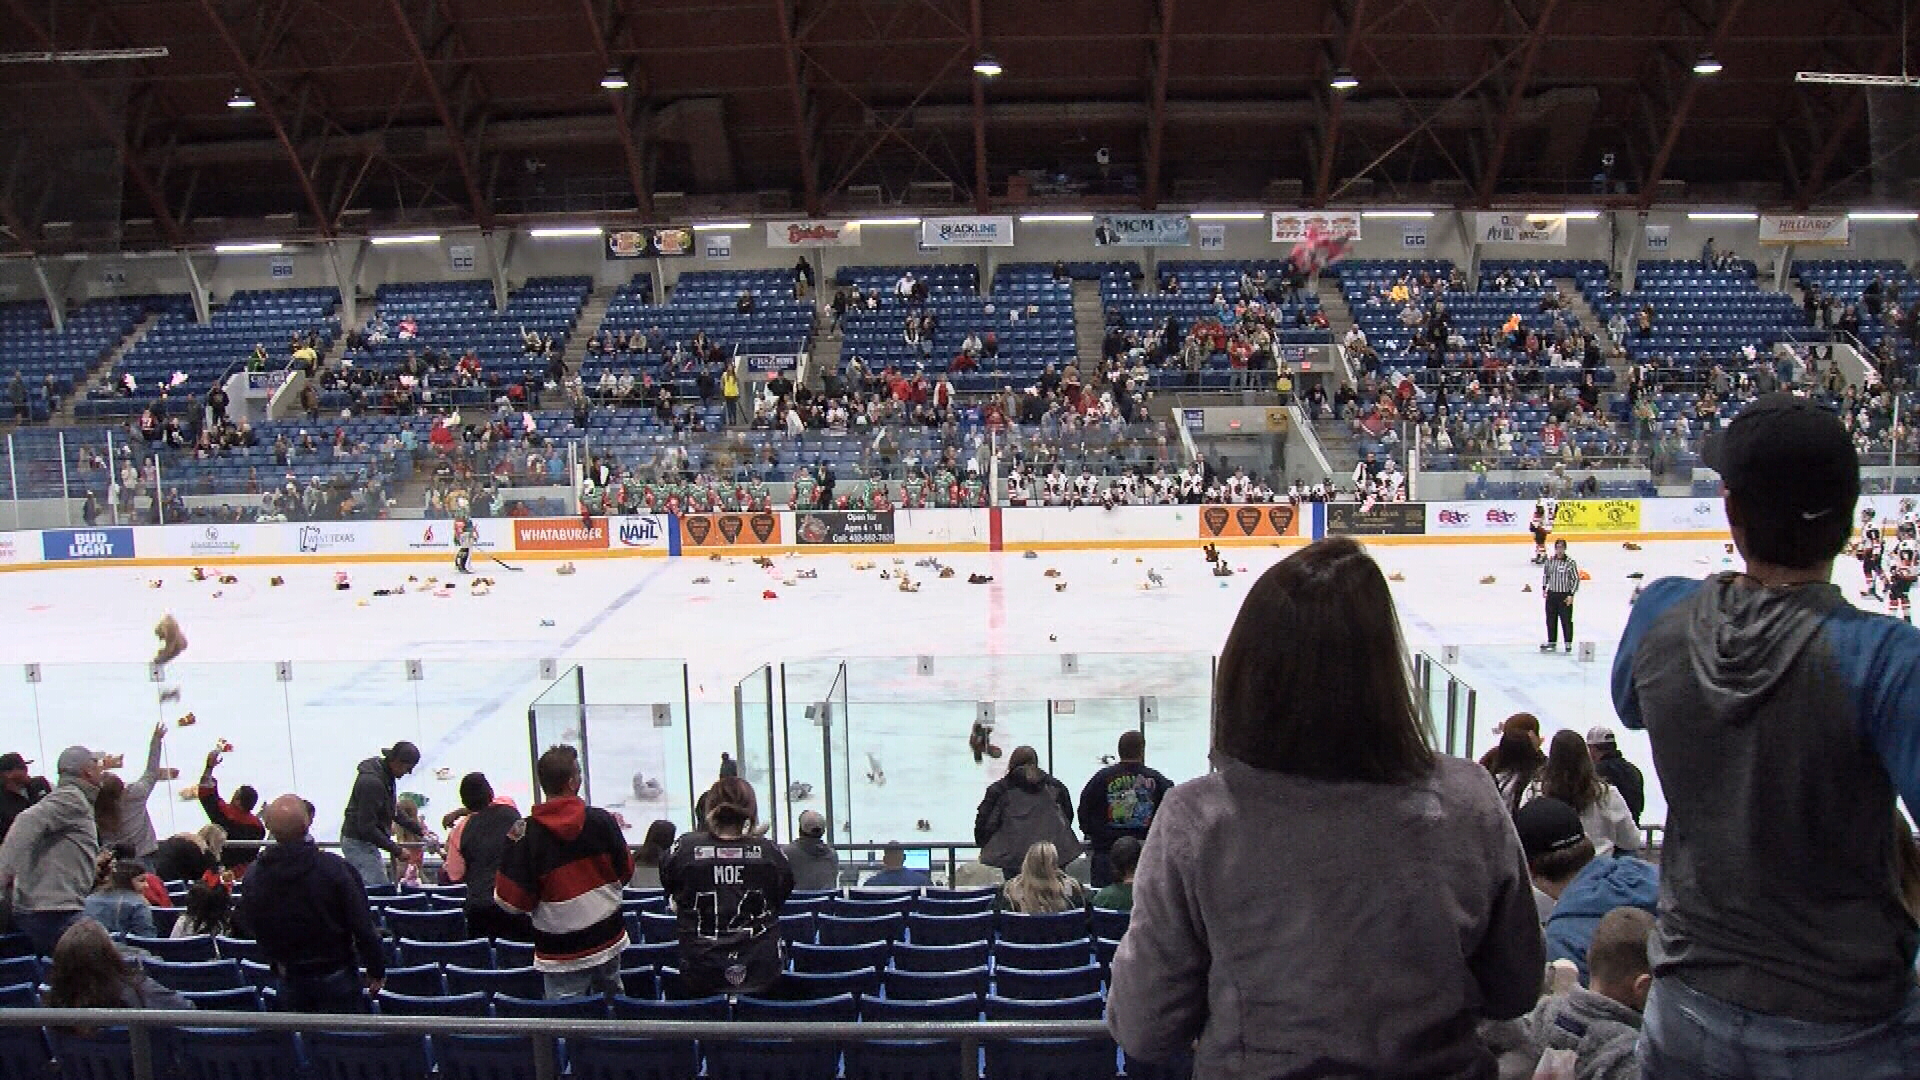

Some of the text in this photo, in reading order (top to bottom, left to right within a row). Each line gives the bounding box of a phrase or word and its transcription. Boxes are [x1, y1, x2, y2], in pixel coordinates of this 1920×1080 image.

[941, 224, 997, 233] BLACKLINE
[1405, 236, 1425, 246] GG
[1648, 237, 1668, 247] HH
[847, 514, 866, 522] Open
[620, 525, 659, 540] NAHL
[844, 524, 862, 532] Ages
[74, 533, 108, 544] BUD
[330, 533, 356, 543] TEXAS
[520, 528, 603, 541] WHATABURGER
[69, 543, 114, 557] LIGHT
[714, 866, 745, 884] MOE
[694, 890, 771, 940] 14
